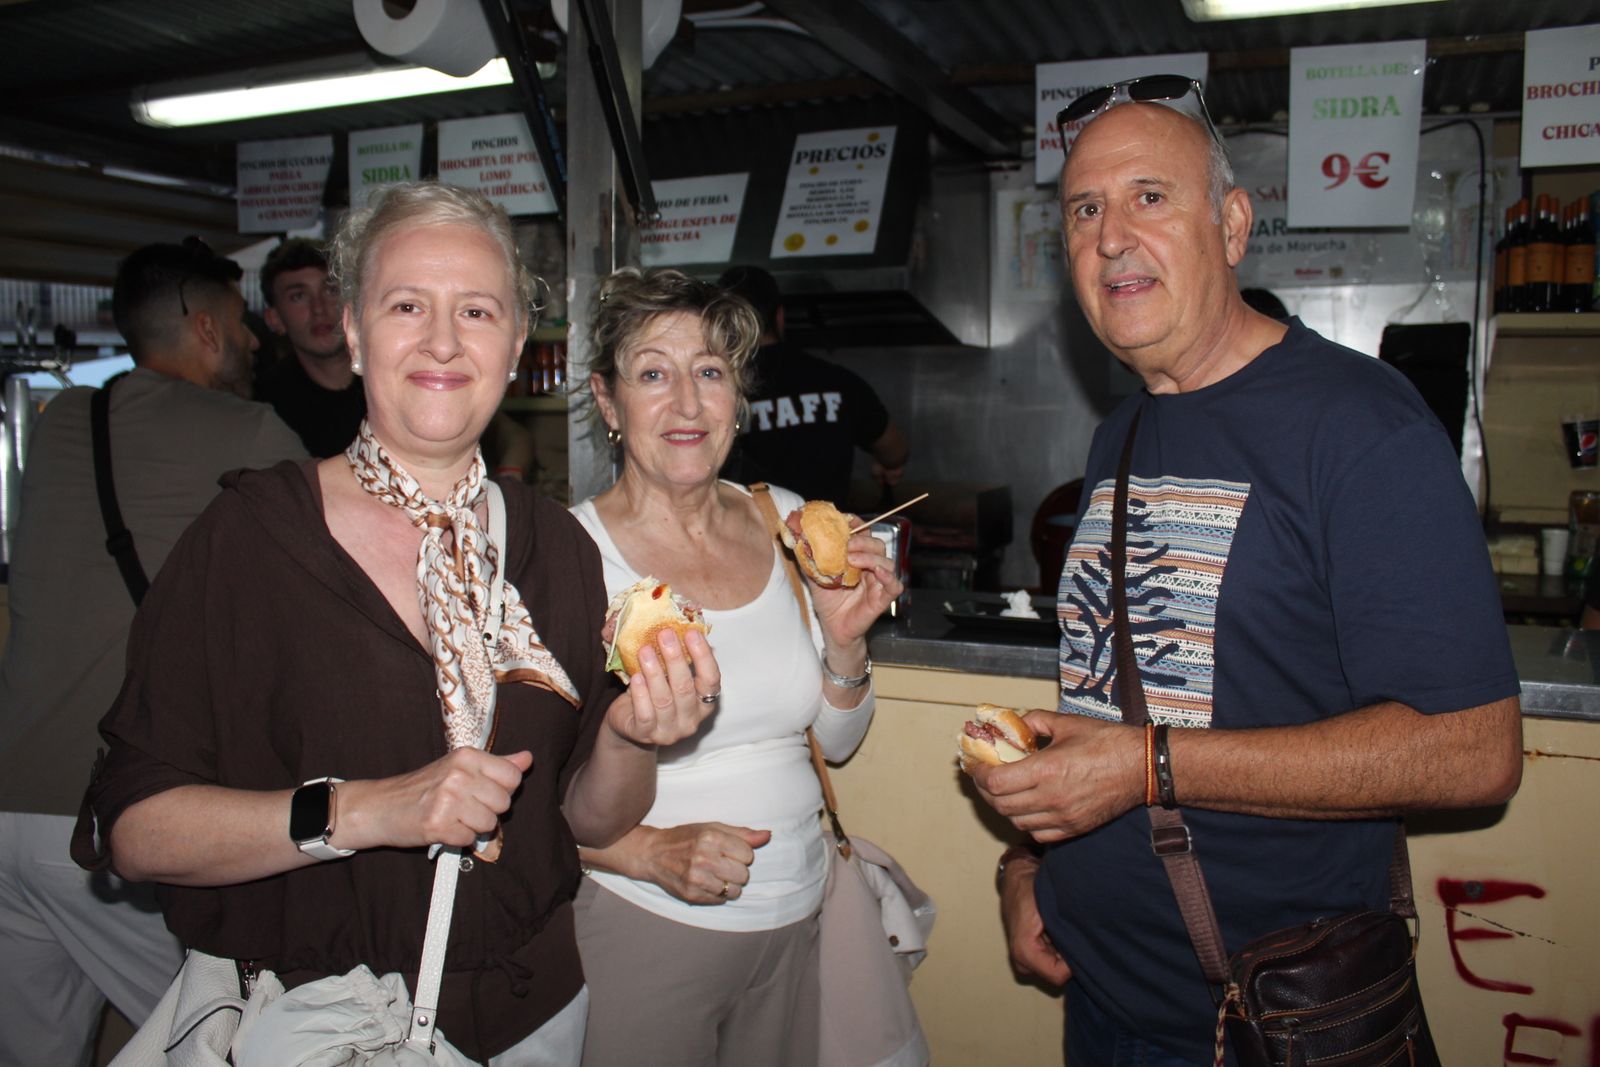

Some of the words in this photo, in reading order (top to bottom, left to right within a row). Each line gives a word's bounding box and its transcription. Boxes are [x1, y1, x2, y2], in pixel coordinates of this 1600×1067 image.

[1313, 95, 1401, 120] SIDRA
[794, 143, 888, 165] PRECIOS
[362, 163, 412, 185] SIDRA
[1321, 151, 1391, 191] 9€
[675, 197, 692, 208] DE
[693, 193, 729, 207] FERIA
